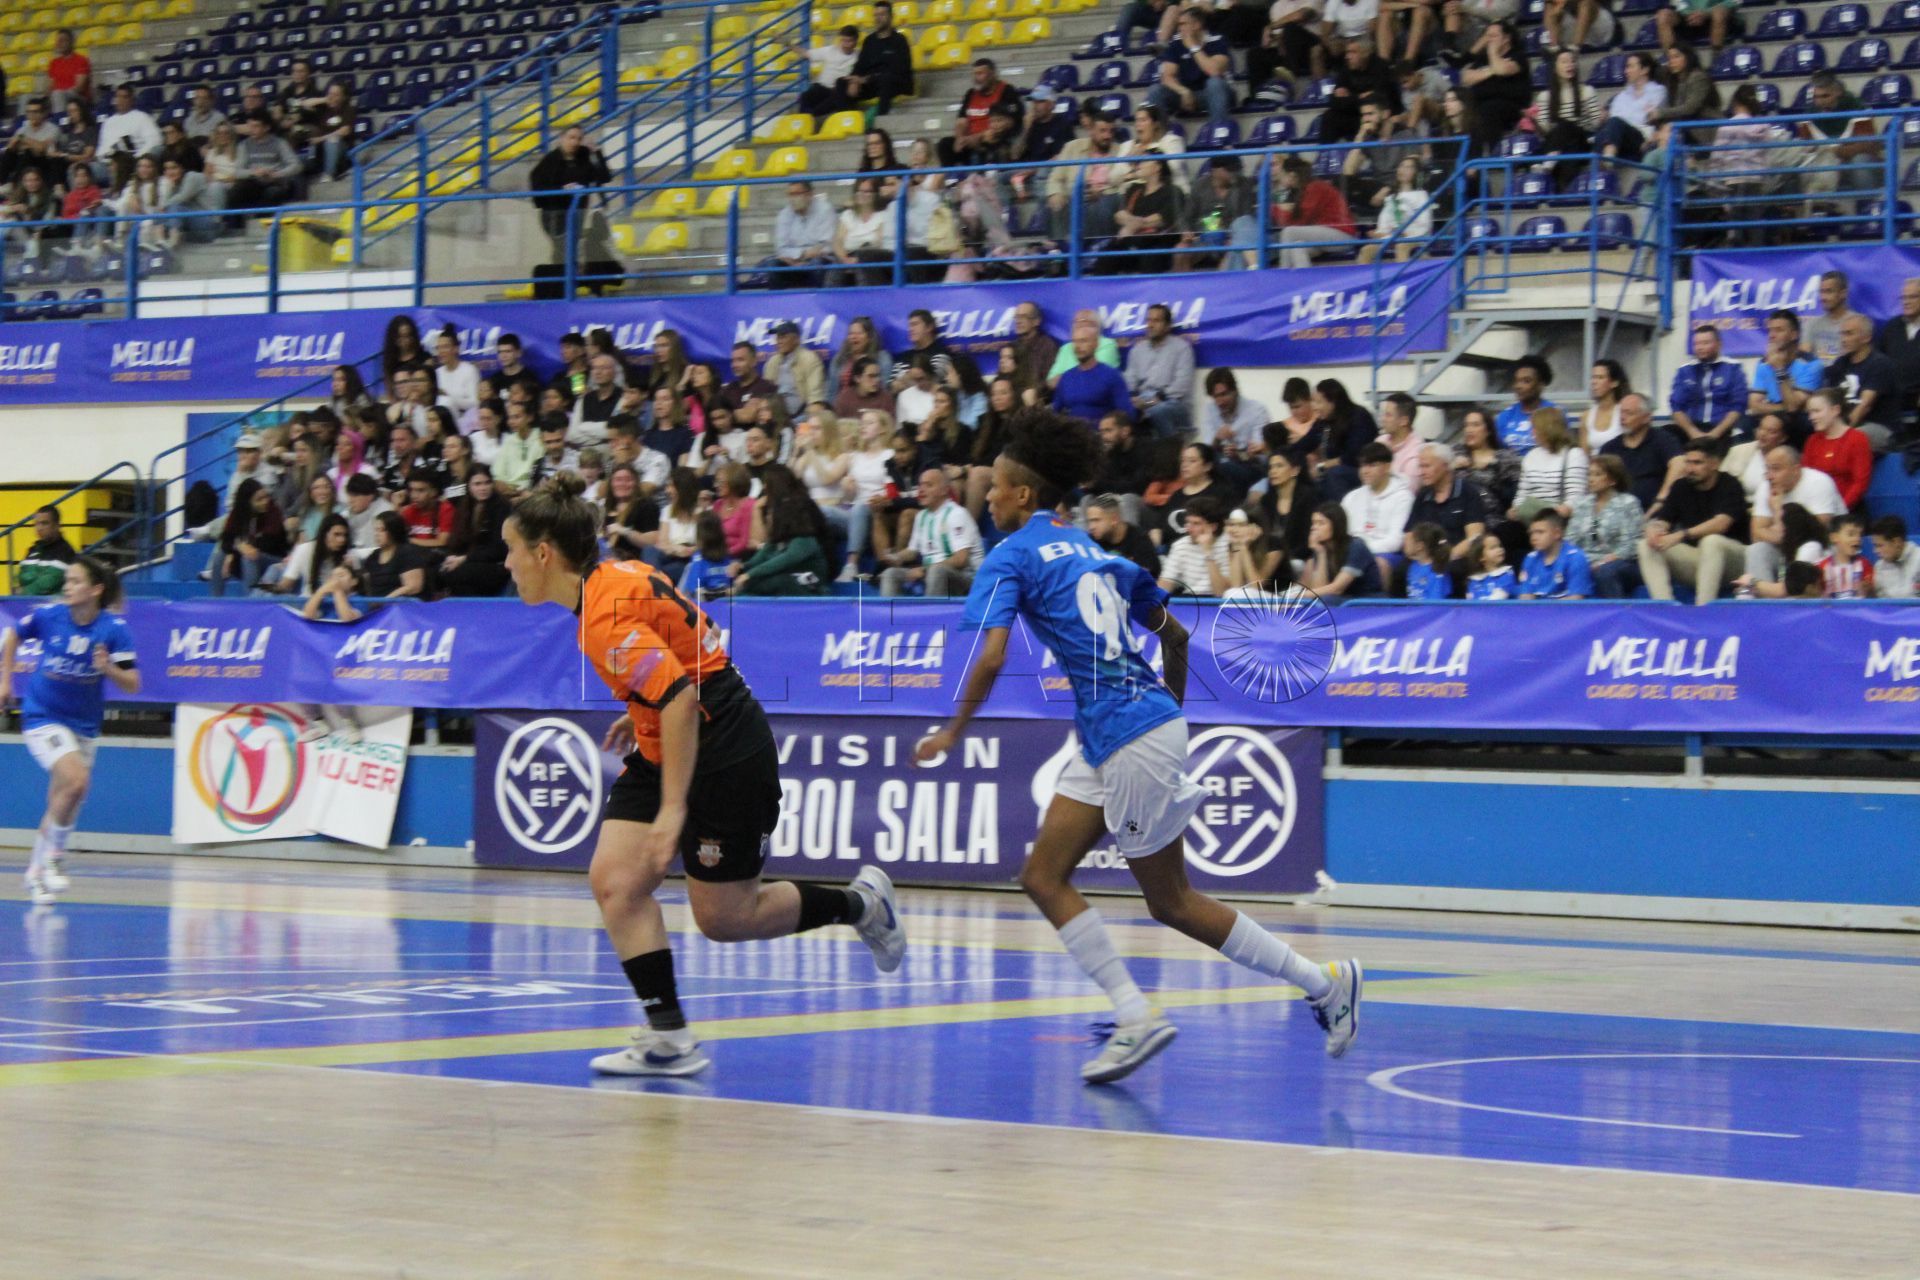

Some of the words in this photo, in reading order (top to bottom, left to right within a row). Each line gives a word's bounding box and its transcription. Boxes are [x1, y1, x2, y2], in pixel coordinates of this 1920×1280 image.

[1690, 274, 1822, 314] MELILLA
[166, 626, 272, 661] MELILLA
[335, 627, 457, 664] MELILLA
[820, 629, 947, 669] MELILLA
[1328, 634, 1474, 677] MELILLA
[1586, 635, 1740, 679] MELILLA
[778, 725, 1000, 768] VISIÓN
[529, 762, 568, 782] RF
[529, 788, 570, 807] EF
[1204, 804, 1254, 825] EF
[770, 777, 861, 857] BOL
[874, 779, 999, 864] SALA
